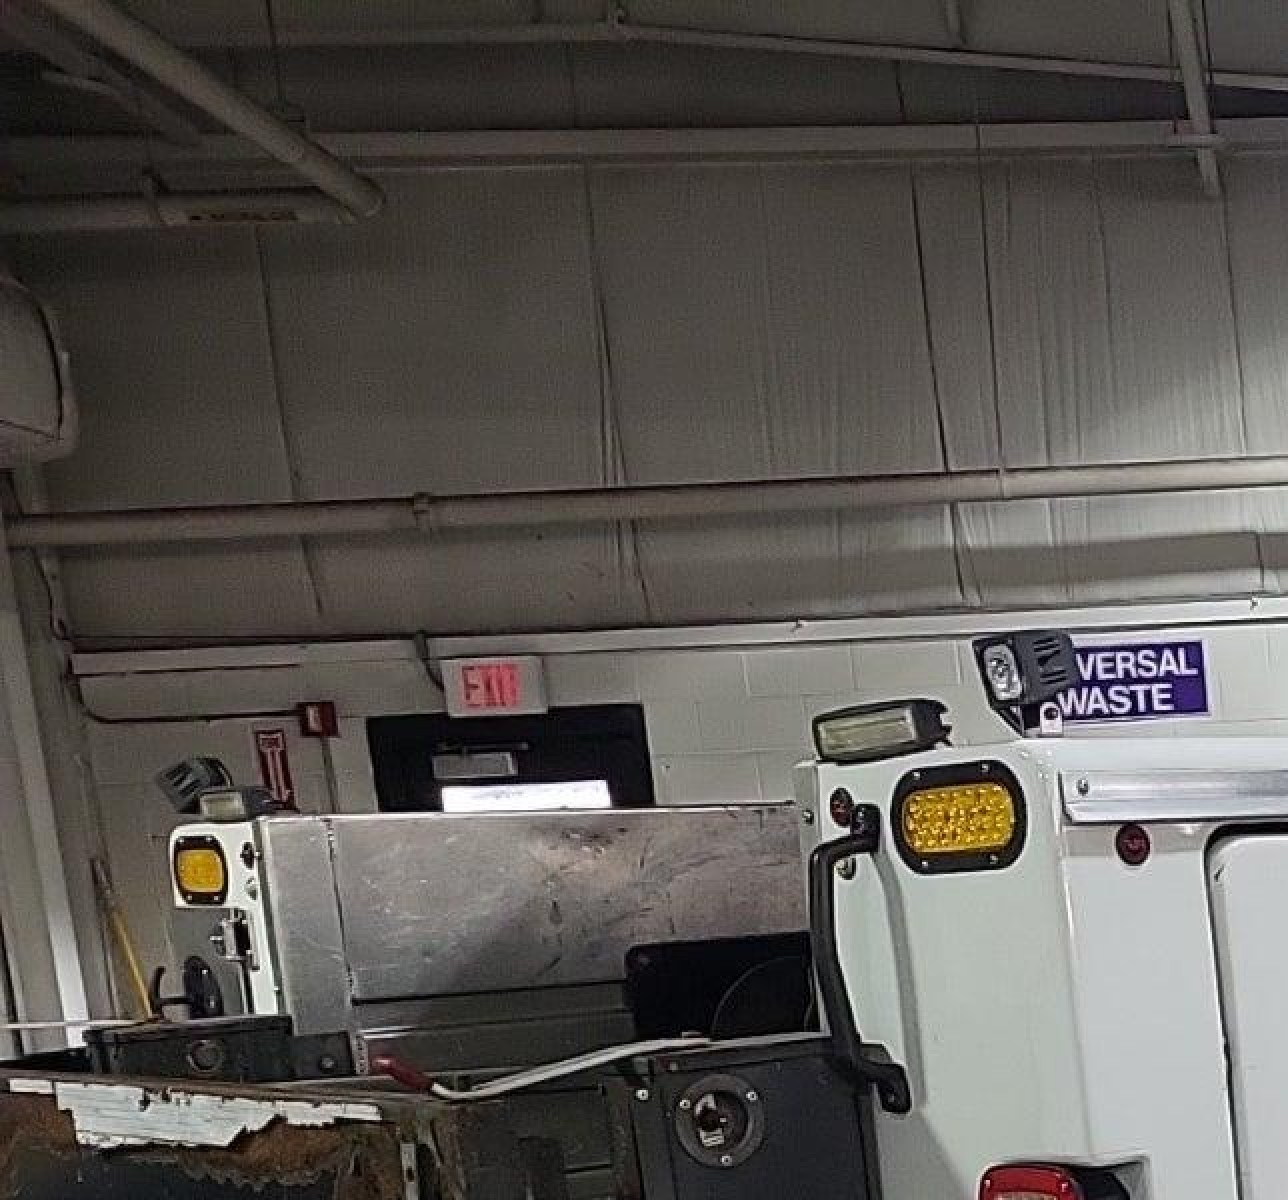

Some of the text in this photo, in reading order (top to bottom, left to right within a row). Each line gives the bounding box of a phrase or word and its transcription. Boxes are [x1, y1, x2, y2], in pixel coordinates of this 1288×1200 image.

[1076, 647, 1198, 681] VERSAL
[462, 664, 519, 707] EXIT
[1056, 683, 1174, 716] WASTE
